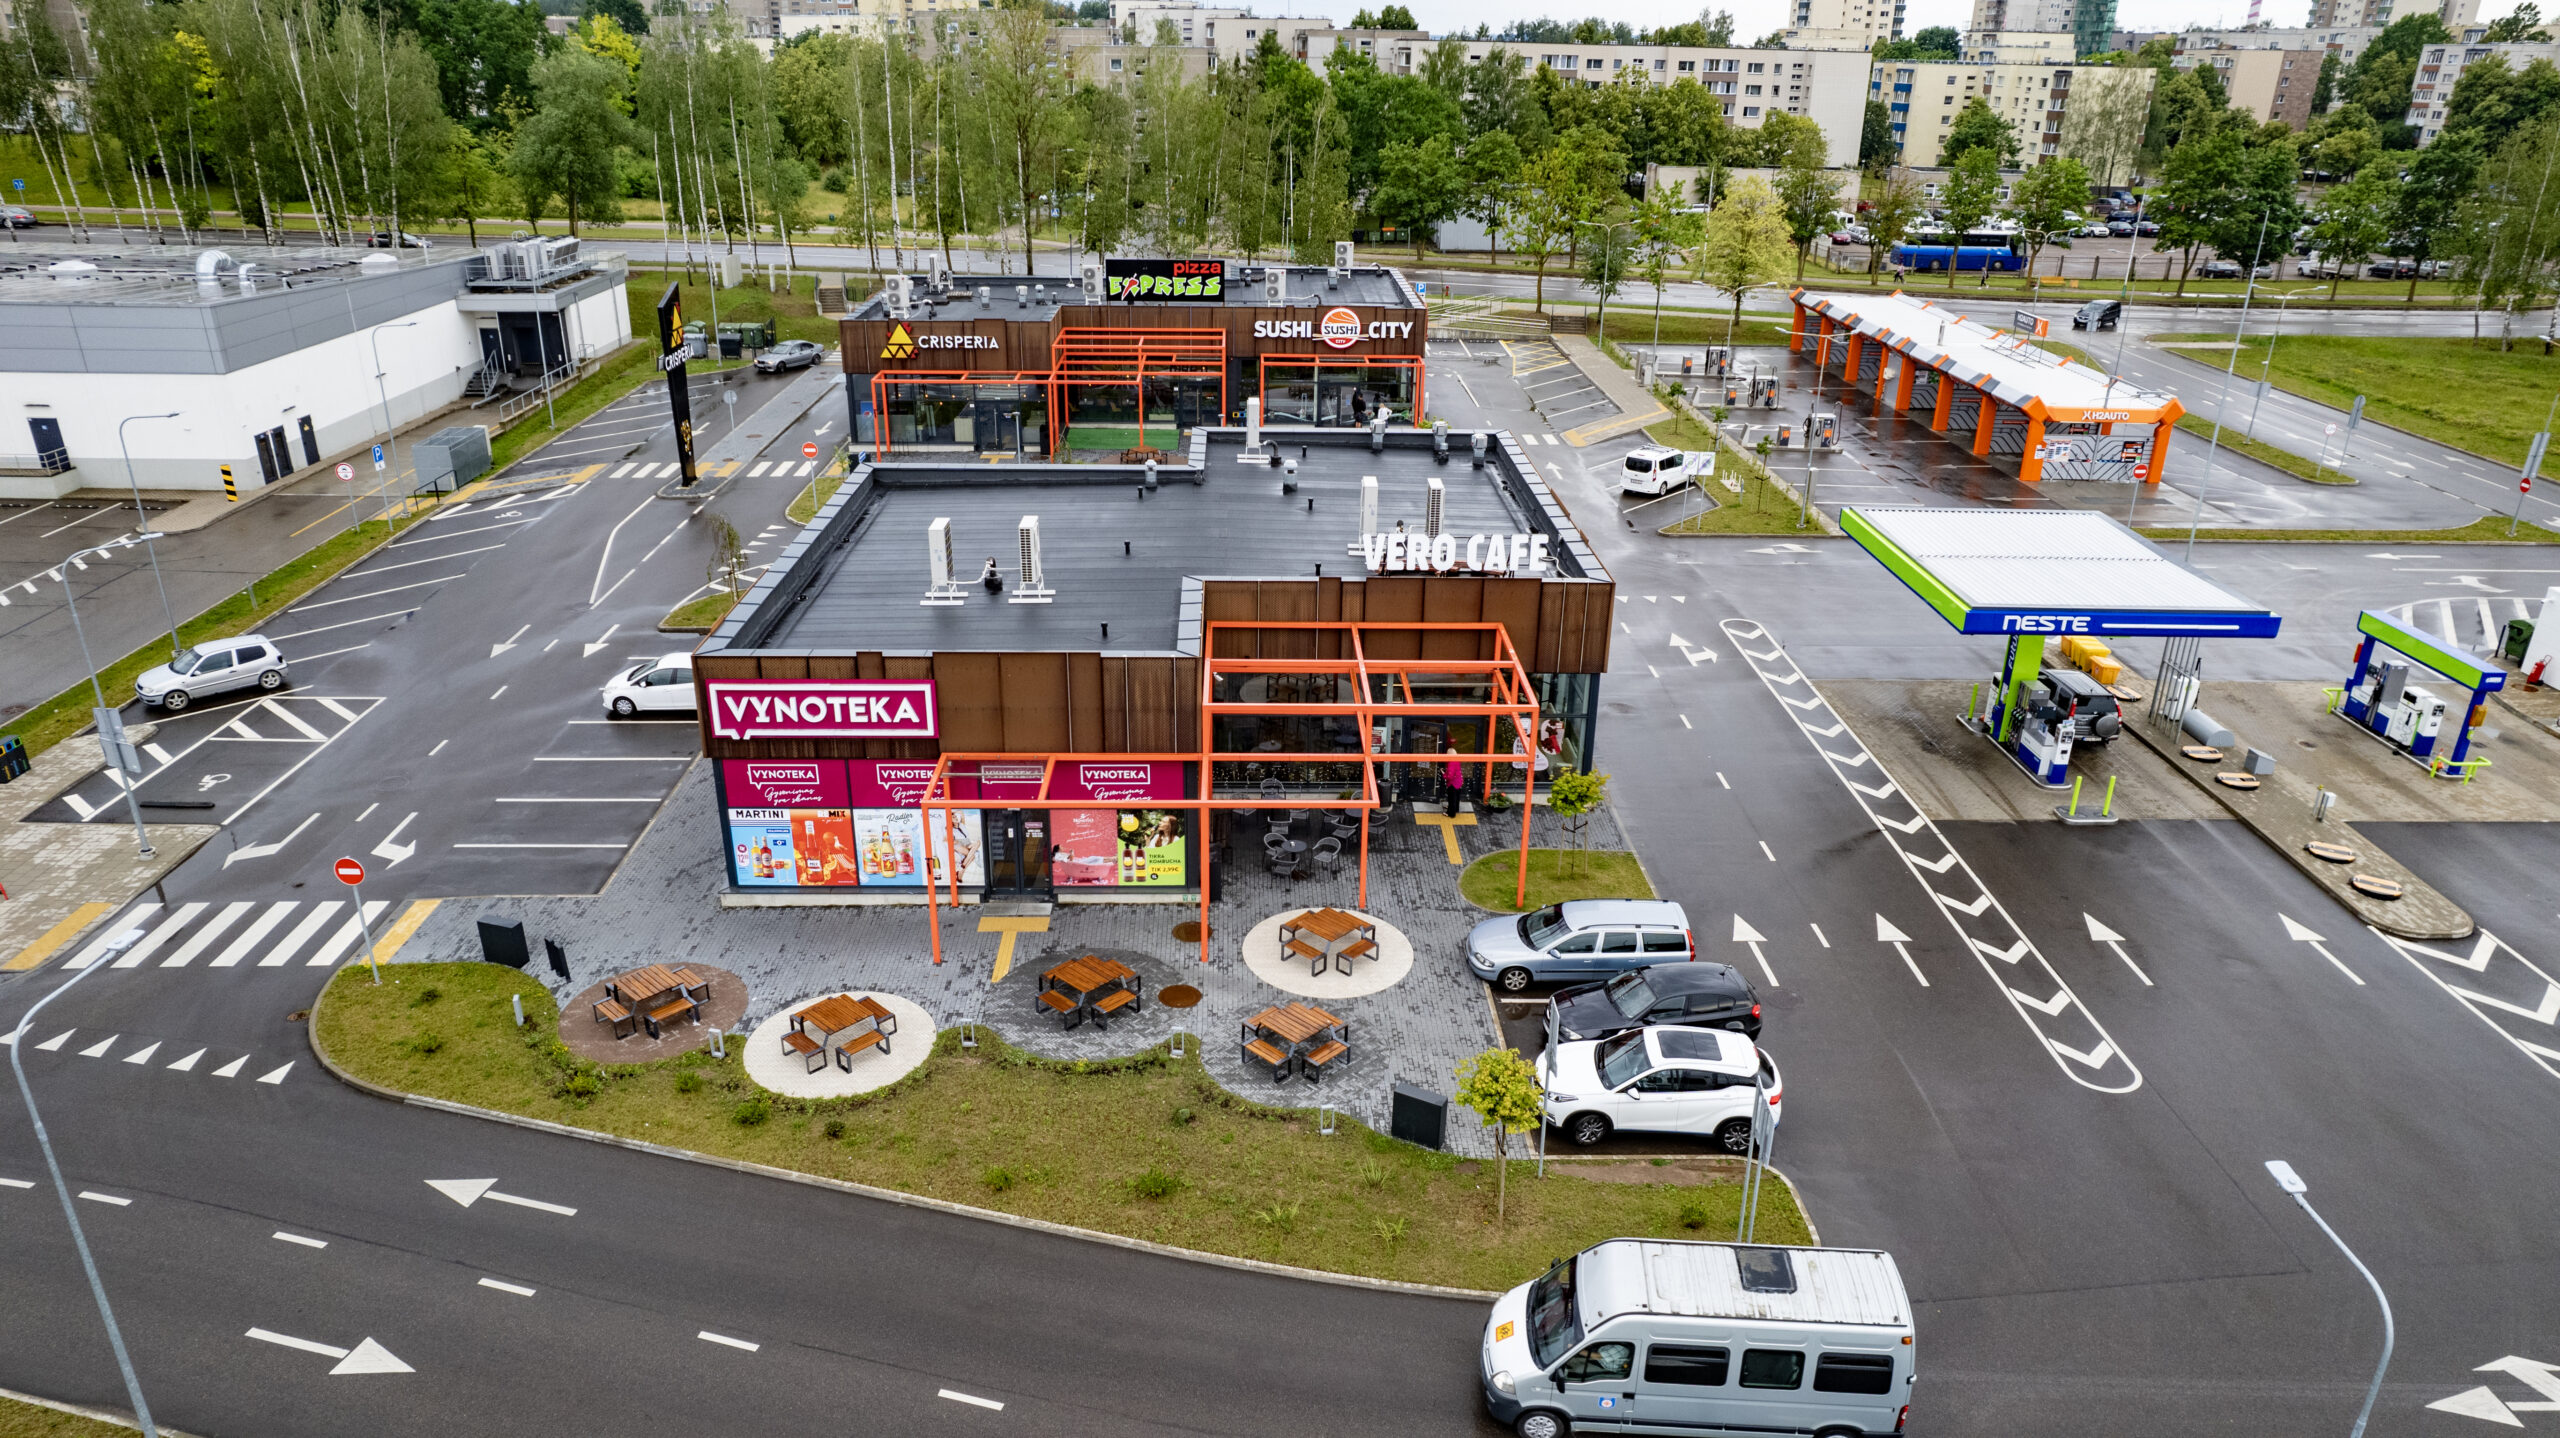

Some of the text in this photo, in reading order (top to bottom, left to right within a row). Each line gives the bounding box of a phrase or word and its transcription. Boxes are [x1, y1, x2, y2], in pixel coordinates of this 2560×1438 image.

[1173, 260, 1221, 277] pizza
[1108, 273, 1221, 299] EXPRESS
[1418, 283, 1425, 292] P
[1253, 320, 1414, 339] SUSHI CITY
[1323, 325, 1358, 335] SUSHI
[918, 335, 1000, 349] CRISPERIA
[665, 344, 695, 372] CRISPERIA
[2092, 411, 2130, 421] H2AUTO
[375, 447, 381, 461] P
[1362, 533, 1549, 572] VERO CAFE
[2002, 615, 2091, 632] NESTE
[723, 695, 921, 723] VYNOTEKA
[752, 769, 815, 779] VYNOTEKA
[881, 769, 934, 779] VYNOTEK
[1084, 770, 1147, 779] VYNOTEKA
[736, 810, 784, 818] MARTINI
